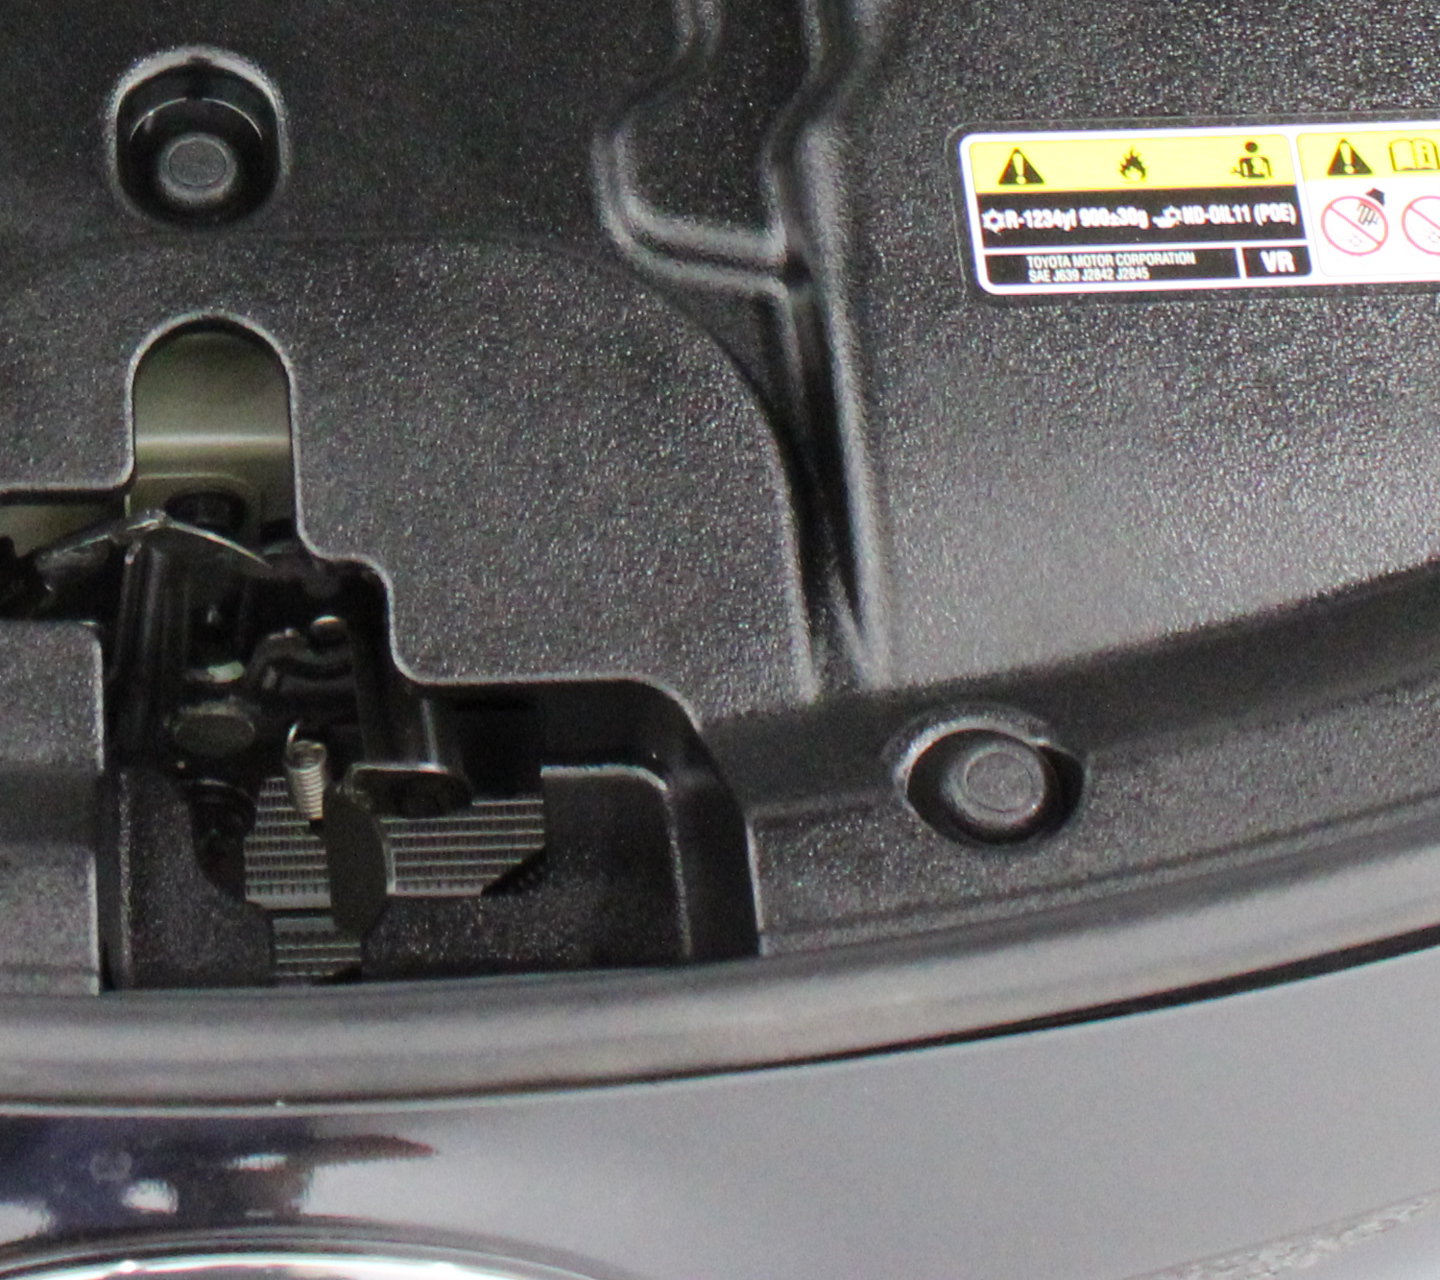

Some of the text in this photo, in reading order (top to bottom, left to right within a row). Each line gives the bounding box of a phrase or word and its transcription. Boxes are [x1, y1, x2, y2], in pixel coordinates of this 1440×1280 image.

[1026, 251, 1197, 269] TOYOTA MOTOR CORPORATION
[1259, 250, 1297, 273] VR
[1028, 269, 1052, 283] SAE
